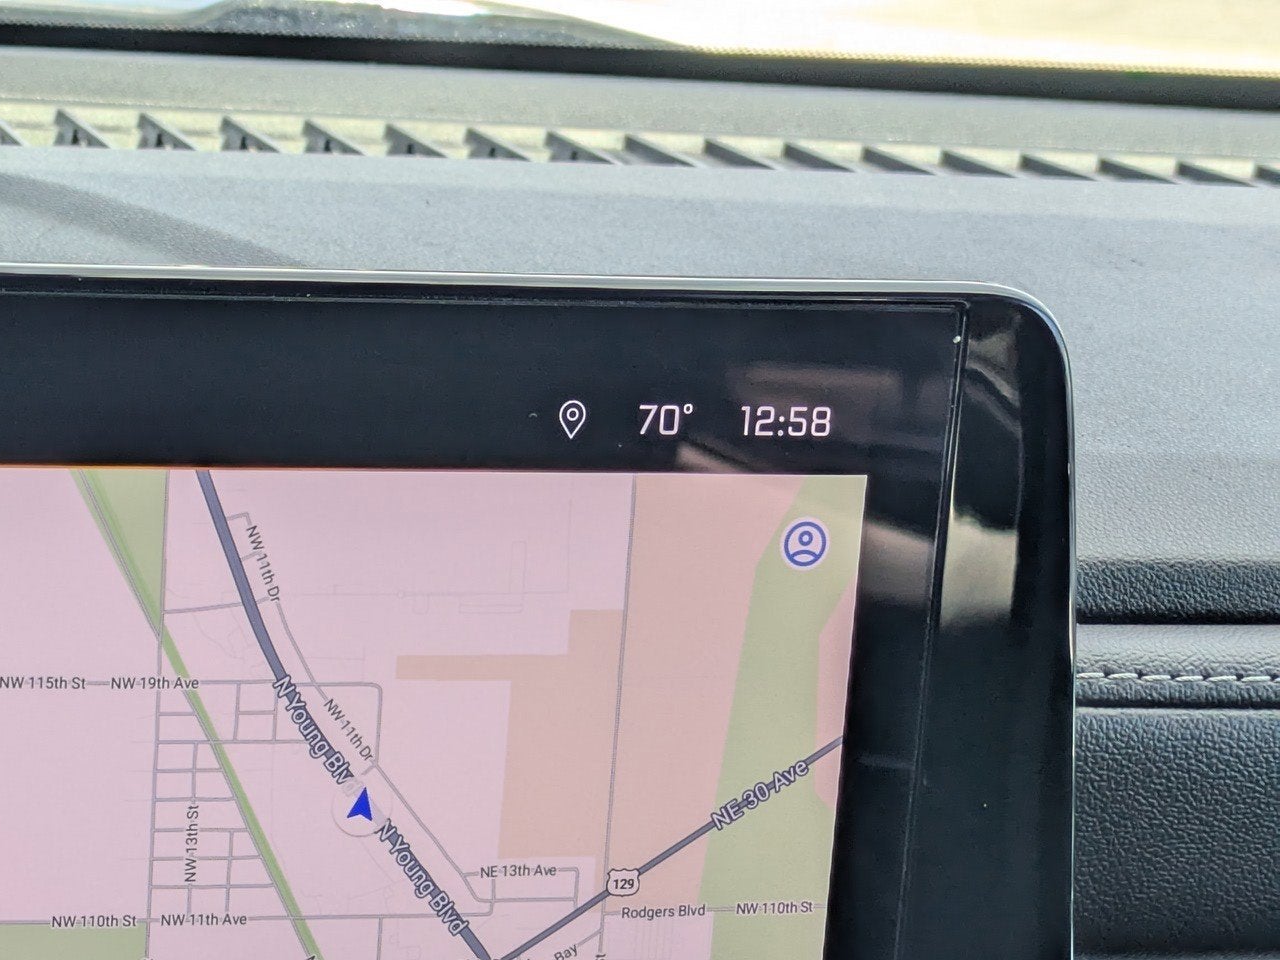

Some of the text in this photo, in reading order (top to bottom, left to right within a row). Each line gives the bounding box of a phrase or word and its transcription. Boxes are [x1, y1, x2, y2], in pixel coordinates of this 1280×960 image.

[639, 403, 693, 436] 70°
[740, 405, 832, 437] 12:58
[246, 525, 280, 602] NW 11th Dr
[0, 677, 86, 689] NW 115th St
[111, 677, 199, 689] NW 19th Ave
[274, 676, 295, 697] N
[286, 693, 329, 758] Young
[324, 699, 373, 761] NW 11th Dr
[711, 760, 809, 830] NE 30 Ave
[185, 805, 200, 882] NW 13th St
[375, 818, 469, 936] N Young Blvd
[480, 864, 556, 877] NE 13th Ave
[613, 878, 634, 890] 129
[621, 905, 706, 920] Rodgers Blvd
[736, 901, 813, 914] NW 110th St
[52, 915, 137, 928] NW 110th St
[161, 914, 247, 926] NW 11th Ave
